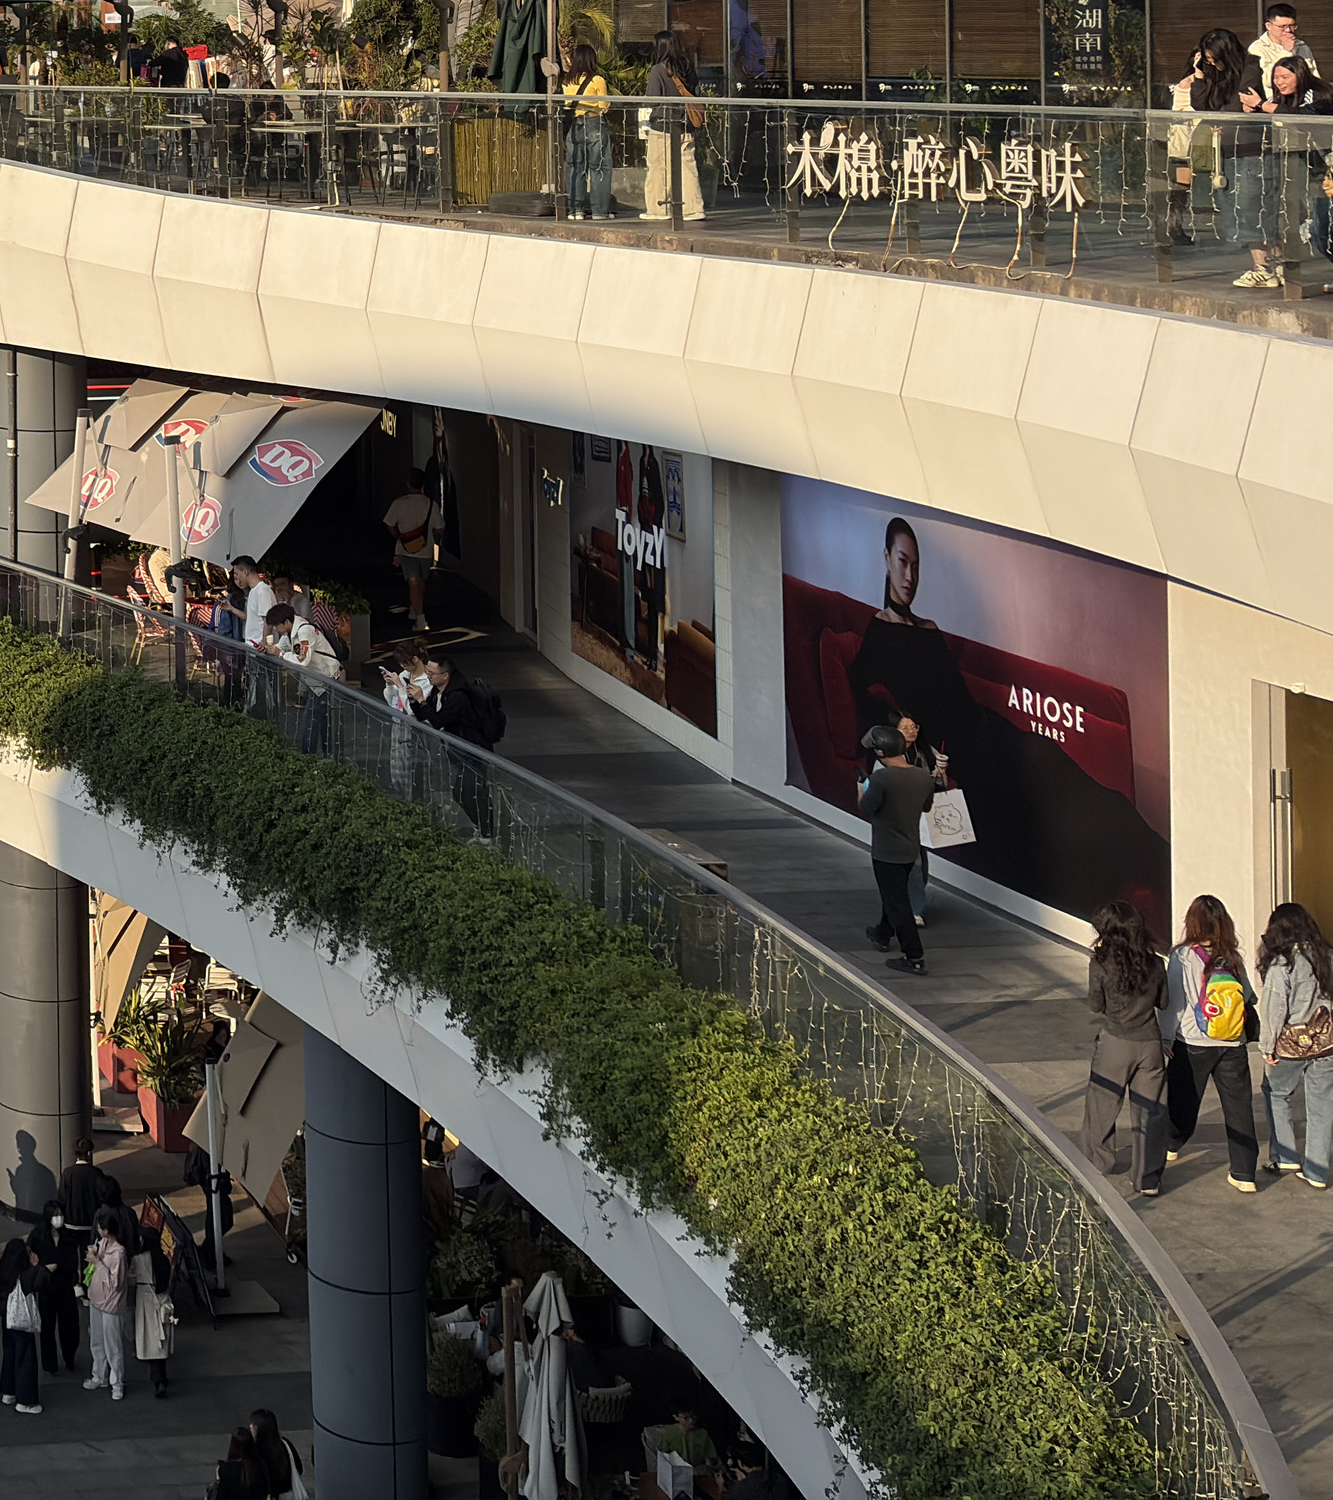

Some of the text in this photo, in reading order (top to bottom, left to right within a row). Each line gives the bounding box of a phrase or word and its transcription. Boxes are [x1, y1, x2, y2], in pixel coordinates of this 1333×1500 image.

[1074, 8, 1103, 53] 湖南
[380, 409, 397, 438] JNBY
[259, 445, 313, 483] DQ
[1008, 684, 1085, 733] ARIOSE
[1030, 720, 1065, 743] YEARS
